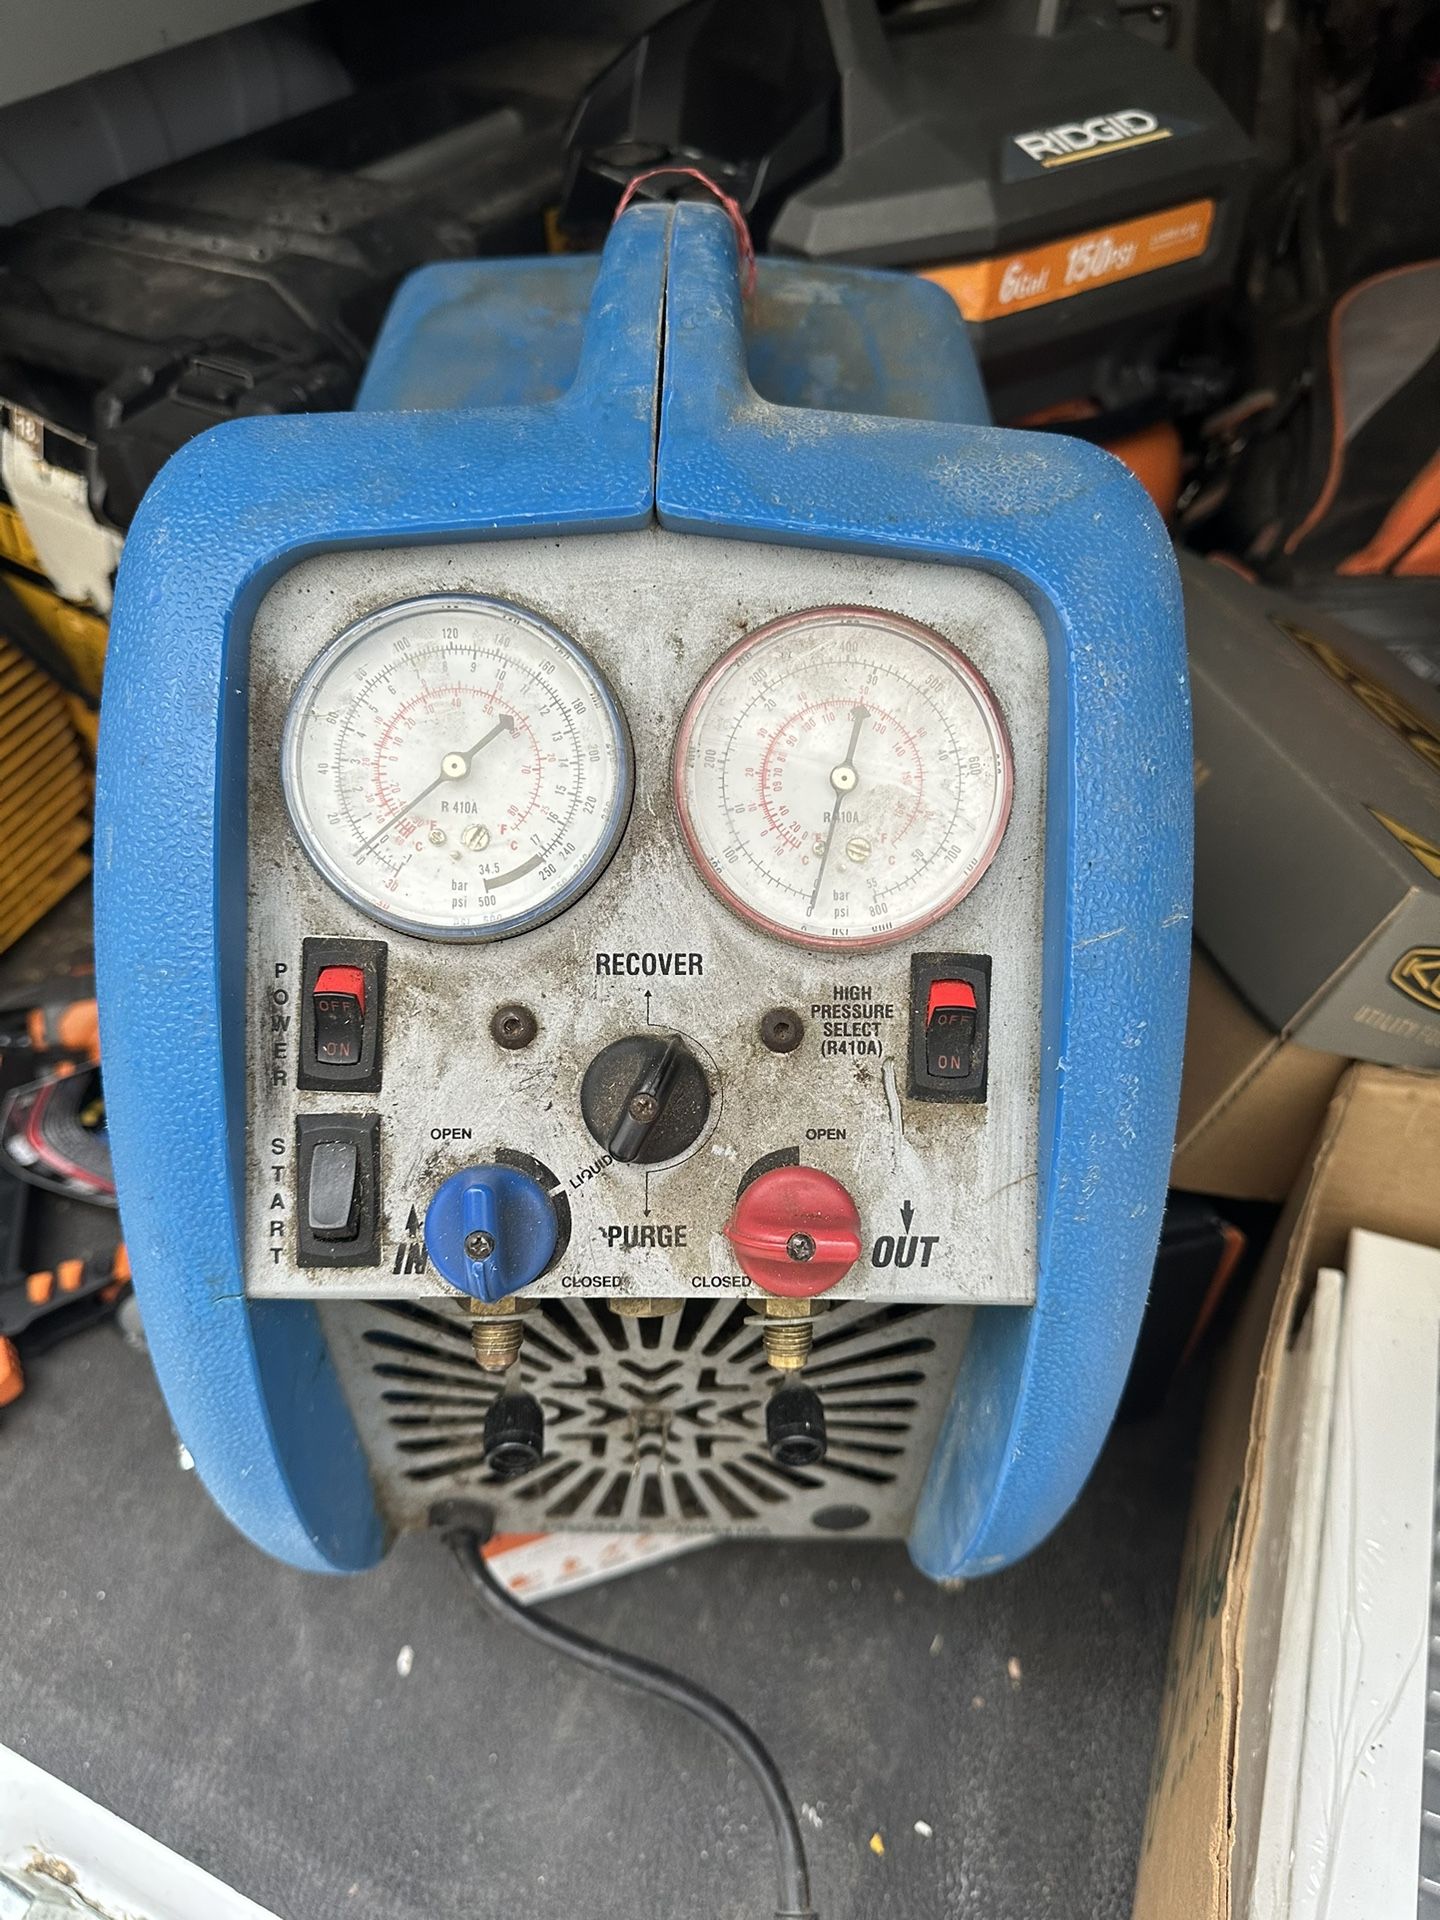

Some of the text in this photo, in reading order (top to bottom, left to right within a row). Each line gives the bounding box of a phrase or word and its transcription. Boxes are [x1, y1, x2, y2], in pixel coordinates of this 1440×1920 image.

[1014, 109, 1159, 161] RIDGID
[442, 628, 459, 639] 120
[393, 636, 411, 653] 100
[494, 634, 511, 648] 140
[470, 662, 477, 673] 9
[538, 660, 556, 675] 160
[495, 669, 506, 681] 10
[749, 667, 768, 687] 300
[866, 674, 878, 686] 30
[387, 685, 397, 695] 6
[925, 674, 944, 693] 500
[859, 686, 869, 695] 50
[368, 705, 379, 713] 5
[539, 704, 551, 717] 12
[571, 698, 587, 715] 180
[764, 698, 777, 712] 20
[326, 711, 339, 725] 60
[404, 717, 416, 730] 20
[822, 712, 836, 724] 110
[757, 727, 768, 739] 30
[871, 722, 887, 735] 130
[551, 731, 563, 742] 13
[786, 735, 798, 748] 90
[588, 743, 601, 763] 200
[892, 742, 906, 757] 140
[558, 758, 569, 768] 14
[704, 749, 717, 768] 200
[318, 762, 329, 775] 40
[745, 768, 754, 777] 20
[773, 768, 783, 777] 70
[969, 756, 982, 776] 600
[555, 785, 567, 796] 15
[772, 781, 782, 792] 60
[441, 801, 477, 814] R 410A
[583, 796, 598, 815] 220
[734, 803, 745, 814] 10
[779, 804, 789, 816] 40
[327, 812, 340, 825] 20
[547, 811, 560, 824] 16
[823, 812, 831, 823] R
[789, 821, 801, 833] 20
[530, 834, 542, 846] 17
[559, 842, 576, 861] 240
[722, 846, 739, 864] 100
[911, 848, 925, 862] 50
[944, 844, 962, 864] 700
[479, 863, 500, 875] 34.5
[539, 863, 557, 881] 250
[451, 879, 468, 890] bar
[866, 877, 878, 889] 55
[478, 895, 497, 908] 500
[833, 890, 850, 901] bar
[452, 896, 467, 909] psi
[834, 907, 849, 918] psi
[868, 902, 888, 917] 800
[595, 953, 703, 976] RECOVER
[833, 986, 872, 1000] HIGH
[319, 1001, 350, 1012] OFF
[811, 1005, 894, 1019] PRESSURE
[271, 962, 290, 1087] POWER
[938, 1013, 970, 1026] OFF
[823, 1022, 882, 1037] SELECT
[325, 1042, 351, 1056] ON
[821, 1040, 883, 1058] (R410A)
[938, 1056, 961, 1070] ON
[430, 1128, 472, 1140] OPEN
[806, 1129, 846, 1140] OPEN
[569, 1153, 614, 1189] LIQUID
[270, 1137, 286, 1265] START
[607, 1225, 687, 1248] PURGE
[392, 1242, 428, 1275] IN
[871, 1236, 939, 1268] OUT
[561, 1275, 622, 1288] CLOSED
[692, 1276, 752, 1288] CLOSED
